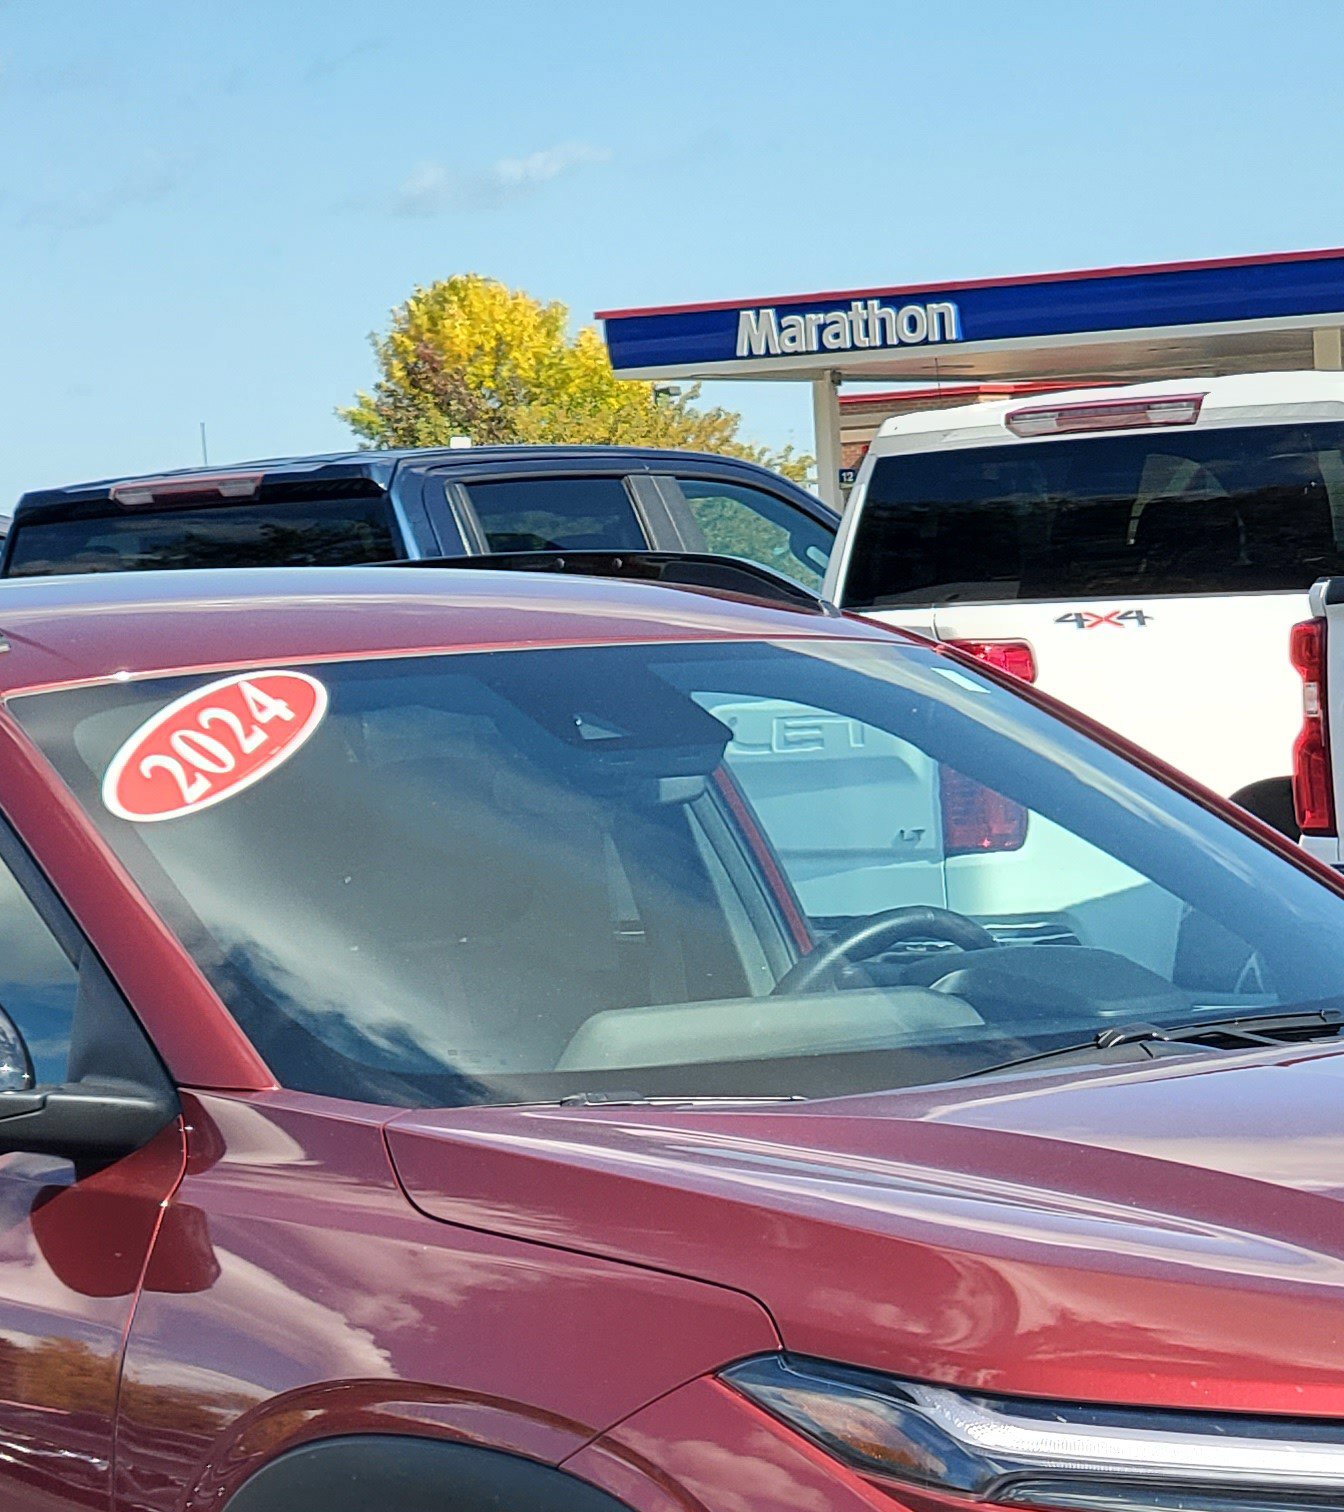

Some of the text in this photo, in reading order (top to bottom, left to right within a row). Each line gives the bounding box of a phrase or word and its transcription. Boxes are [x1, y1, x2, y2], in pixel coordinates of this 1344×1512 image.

[736, 300, 958, 357] Marathon
[841, 471, 854, 482] 12
[139, 680, 295, 804] 2024
[899, 829, 926, 842] LT
